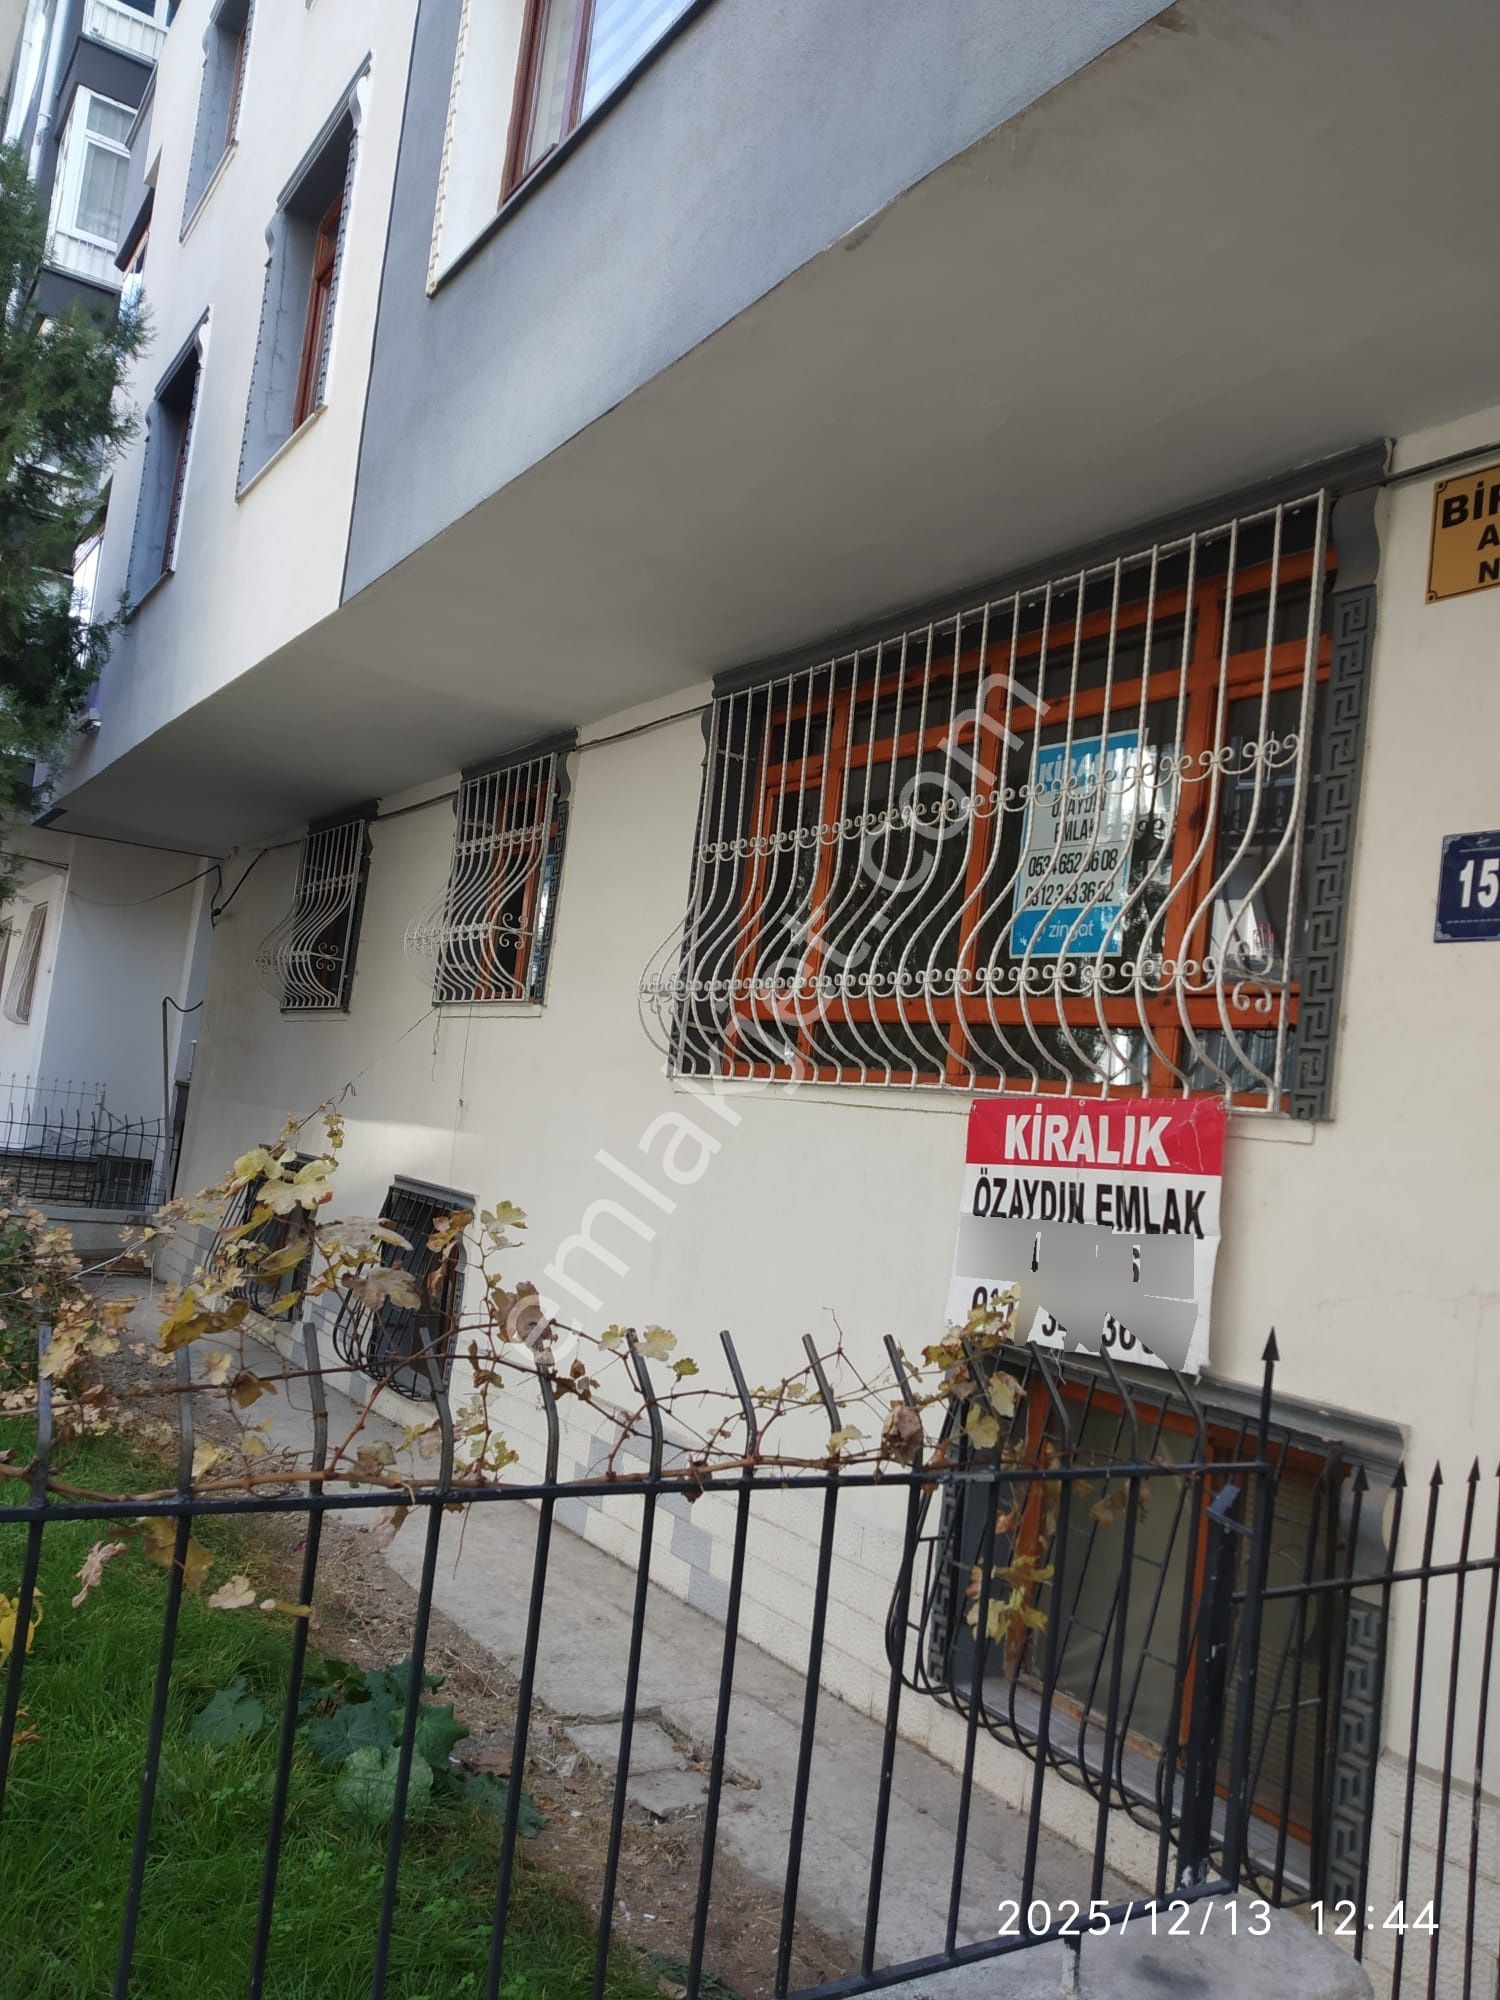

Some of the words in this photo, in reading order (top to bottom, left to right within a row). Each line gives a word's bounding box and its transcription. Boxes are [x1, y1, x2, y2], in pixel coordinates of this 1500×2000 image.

[1039, 750, 1131, 786] KİRA
[1051, 792, 1107, 818] ÖAYDIN
[1059, 851, 1082, 874] 652
[1101, 848, 1119, 871] 08
[1459, 858, 1500, 908] 15
[1048, 919, 1094, 942] zinat
[1004, 1104, 1172, 1166] KİRALIK
[972, 1167, 1085, 1224] ÖZAYDIN
[1096, 1184, 1206, 1239] EMLAK
